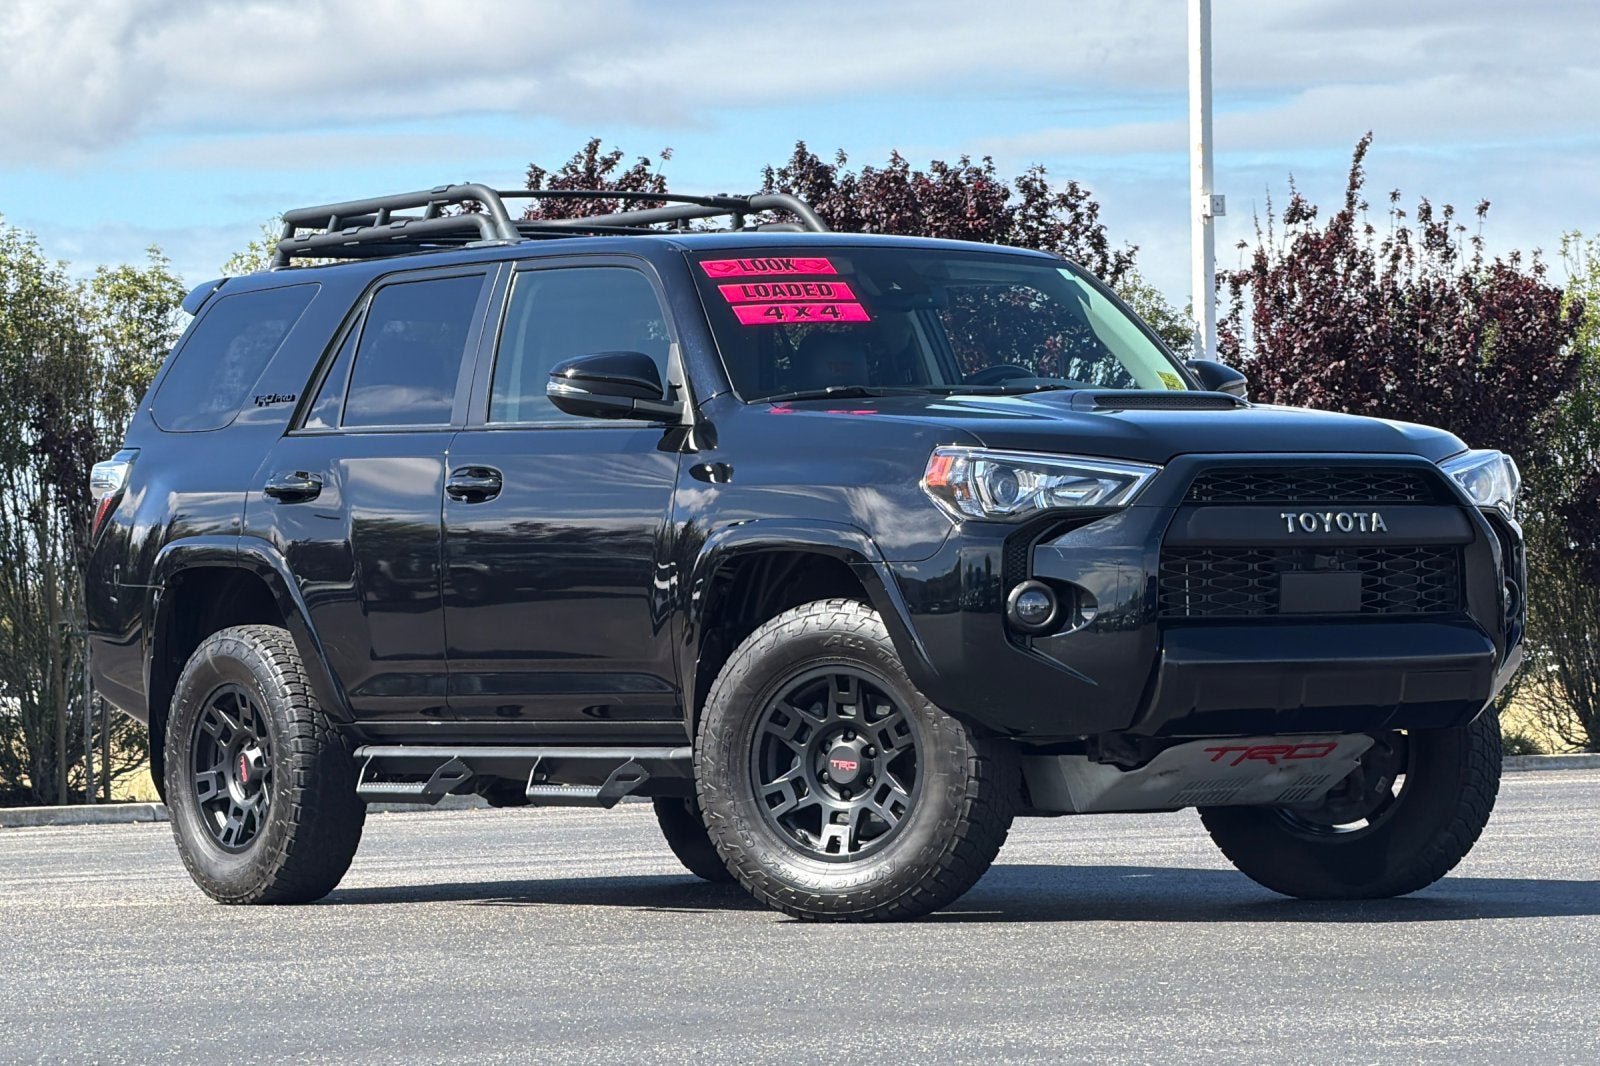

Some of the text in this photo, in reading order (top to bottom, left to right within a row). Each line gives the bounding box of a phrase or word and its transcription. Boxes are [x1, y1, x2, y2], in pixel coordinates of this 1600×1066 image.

[736, 258, 799, 273] LOOK
[741, 283, 835, 299] LOADED
[1280, 511, 1388, 533] TOYOTA
[823, 634, 866, 651] ALL
[1203, 741, 1339, 767] TRD
[830, 758, 858, 772] TRD
